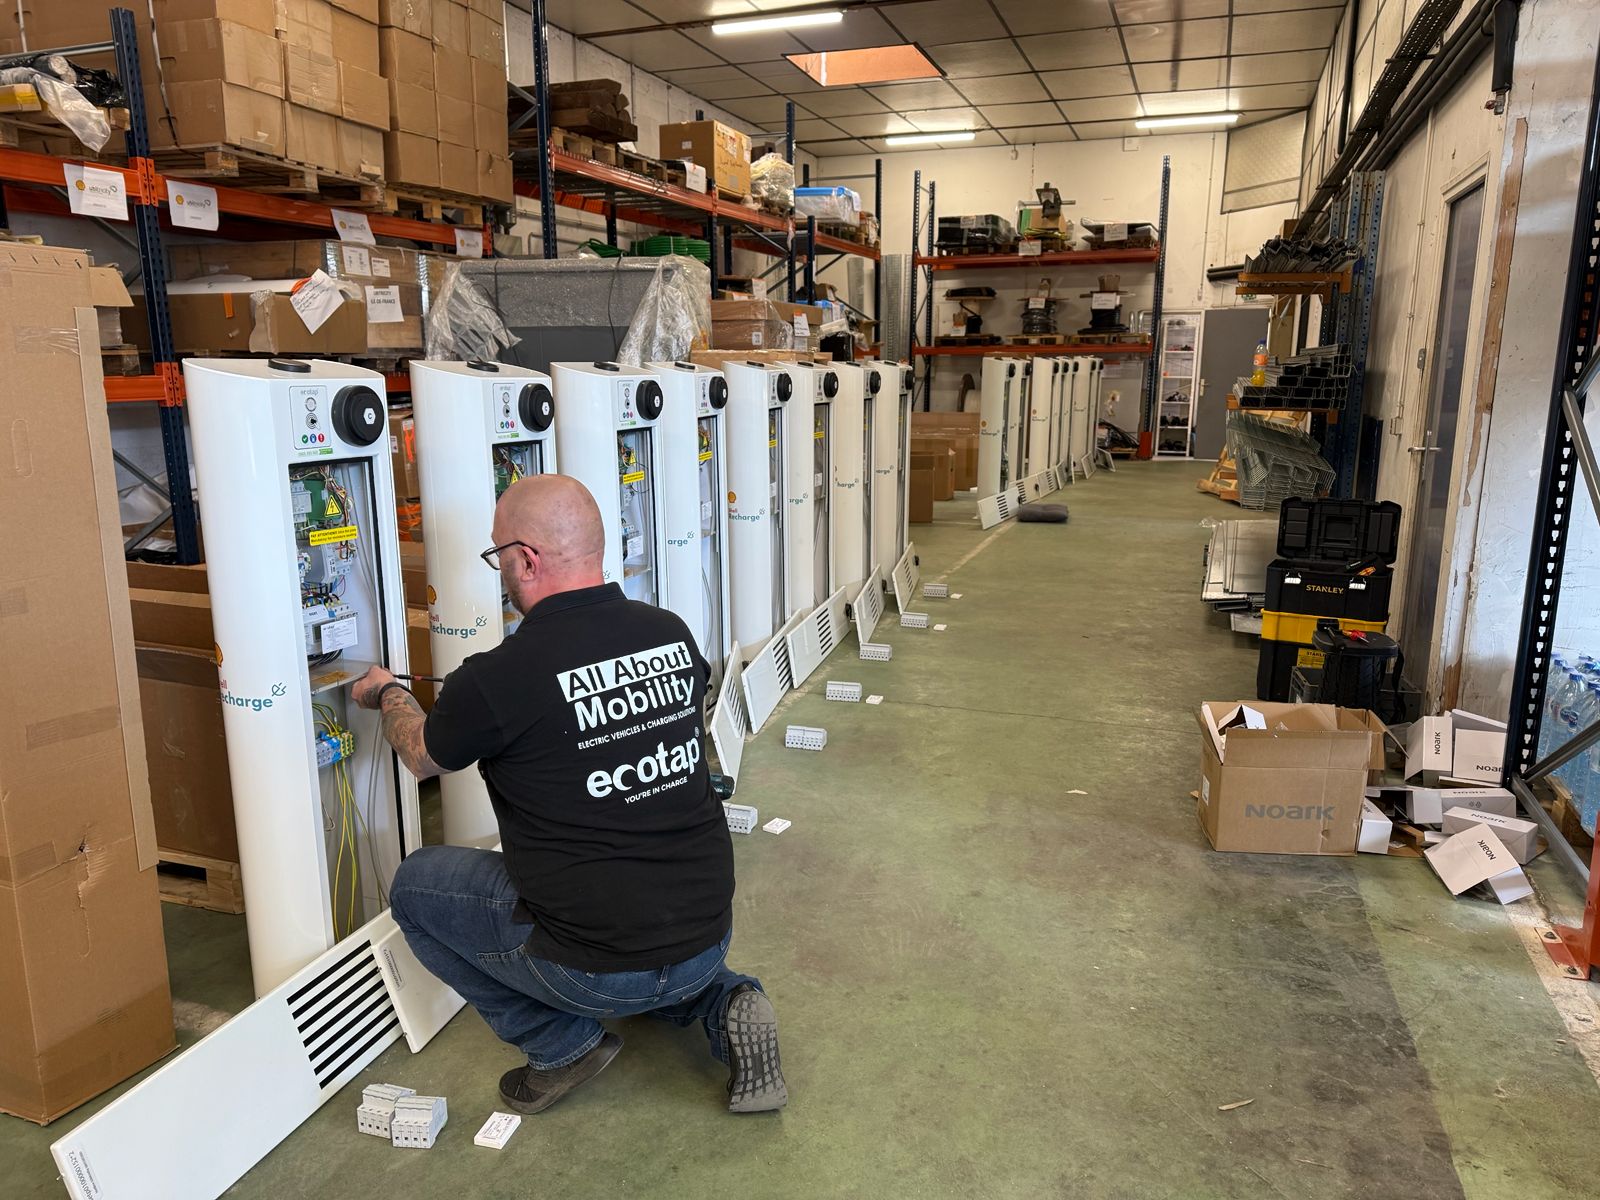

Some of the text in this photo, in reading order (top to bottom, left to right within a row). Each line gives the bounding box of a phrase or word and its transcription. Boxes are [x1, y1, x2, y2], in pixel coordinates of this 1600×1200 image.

[667, 539, 689, 547] arge
[1306, 584, 1344, 594] STANLEY
[569, 644, 690, 698] All About
[574, 674, 695, 732] Mobility
[578, 735, 610, 750] ELECTRIC
[611, 725, 641, 741] VEHICLES
[641, 723, 647, 731] &
[646, 713, 678, 730] CHARGING
[586, 737, 700, 798] ecotap
[624, 776, 688, 804] YOU'RE IN CHARGE
